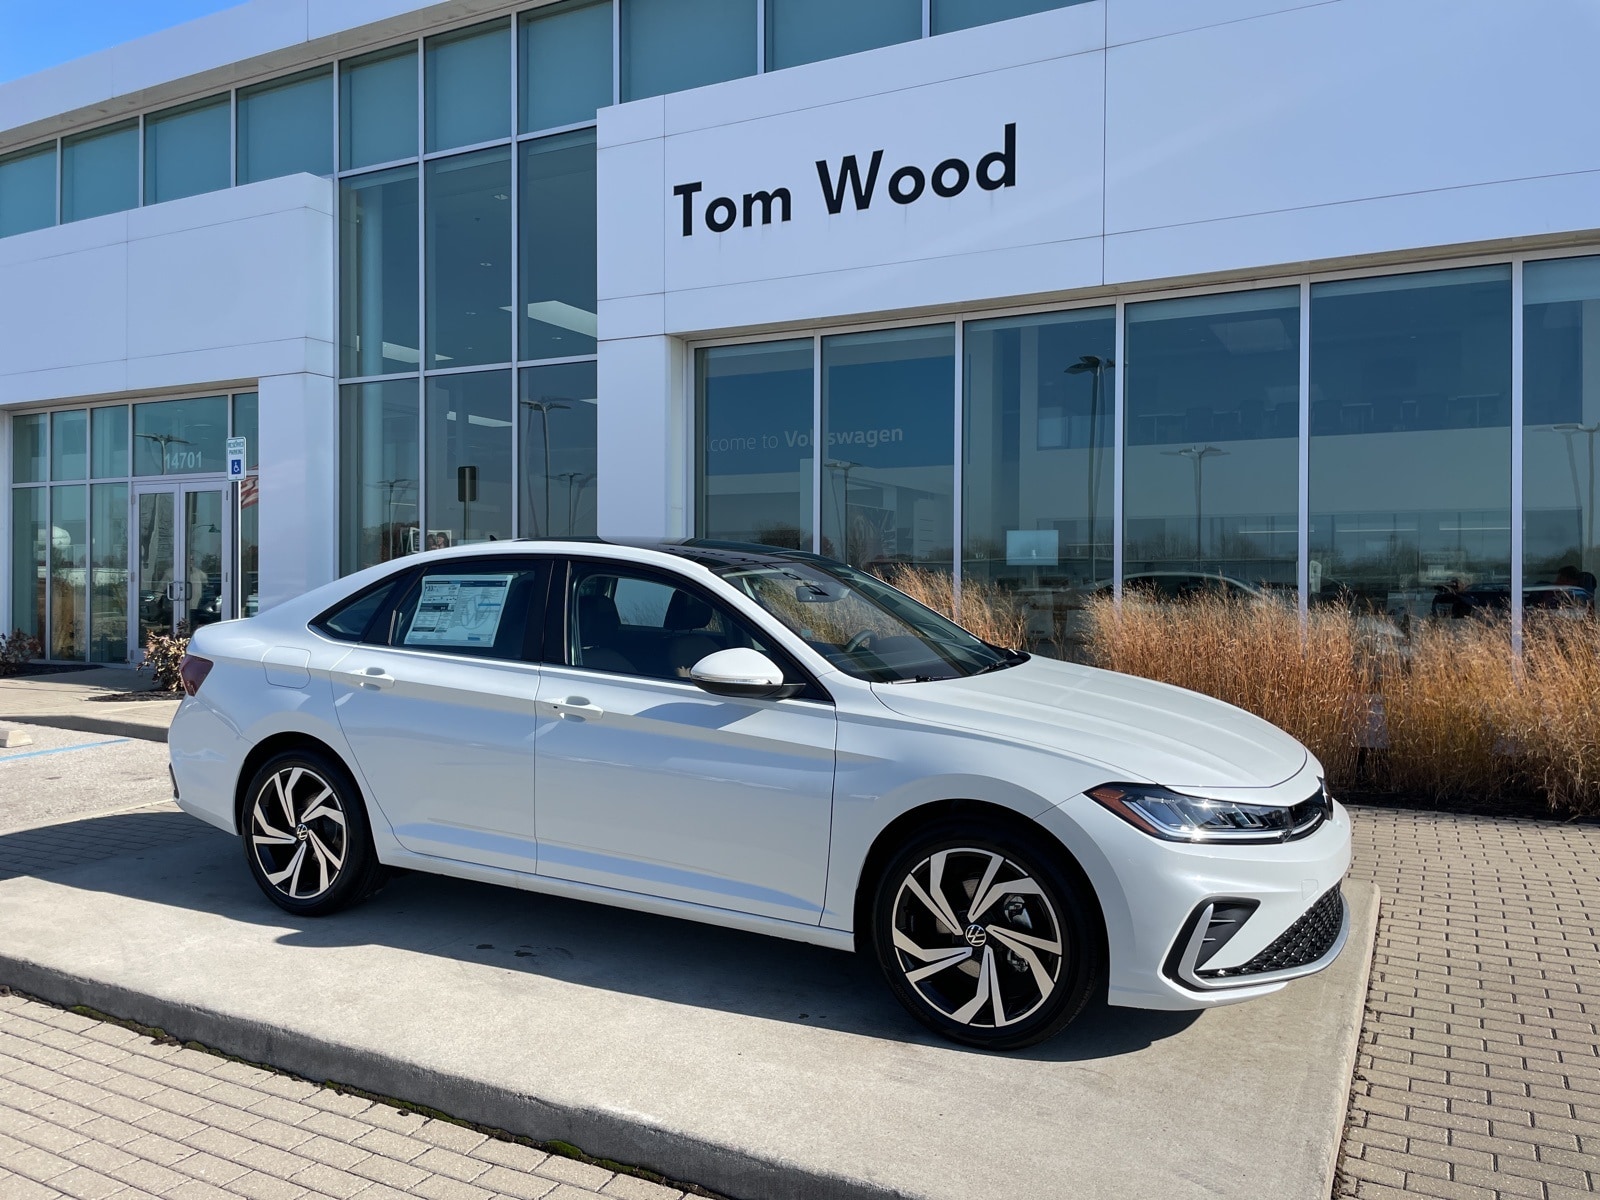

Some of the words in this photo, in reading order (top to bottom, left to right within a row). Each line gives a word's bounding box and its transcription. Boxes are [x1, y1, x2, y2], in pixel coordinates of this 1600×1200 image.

[673, 181, 791, 237] Tom
[815, 122, 1016, 215] Wood
[762, 434, 778, 449] to
[783, 428, 903, 448] Volswagen
[165, 451, 202, 469] 14701
